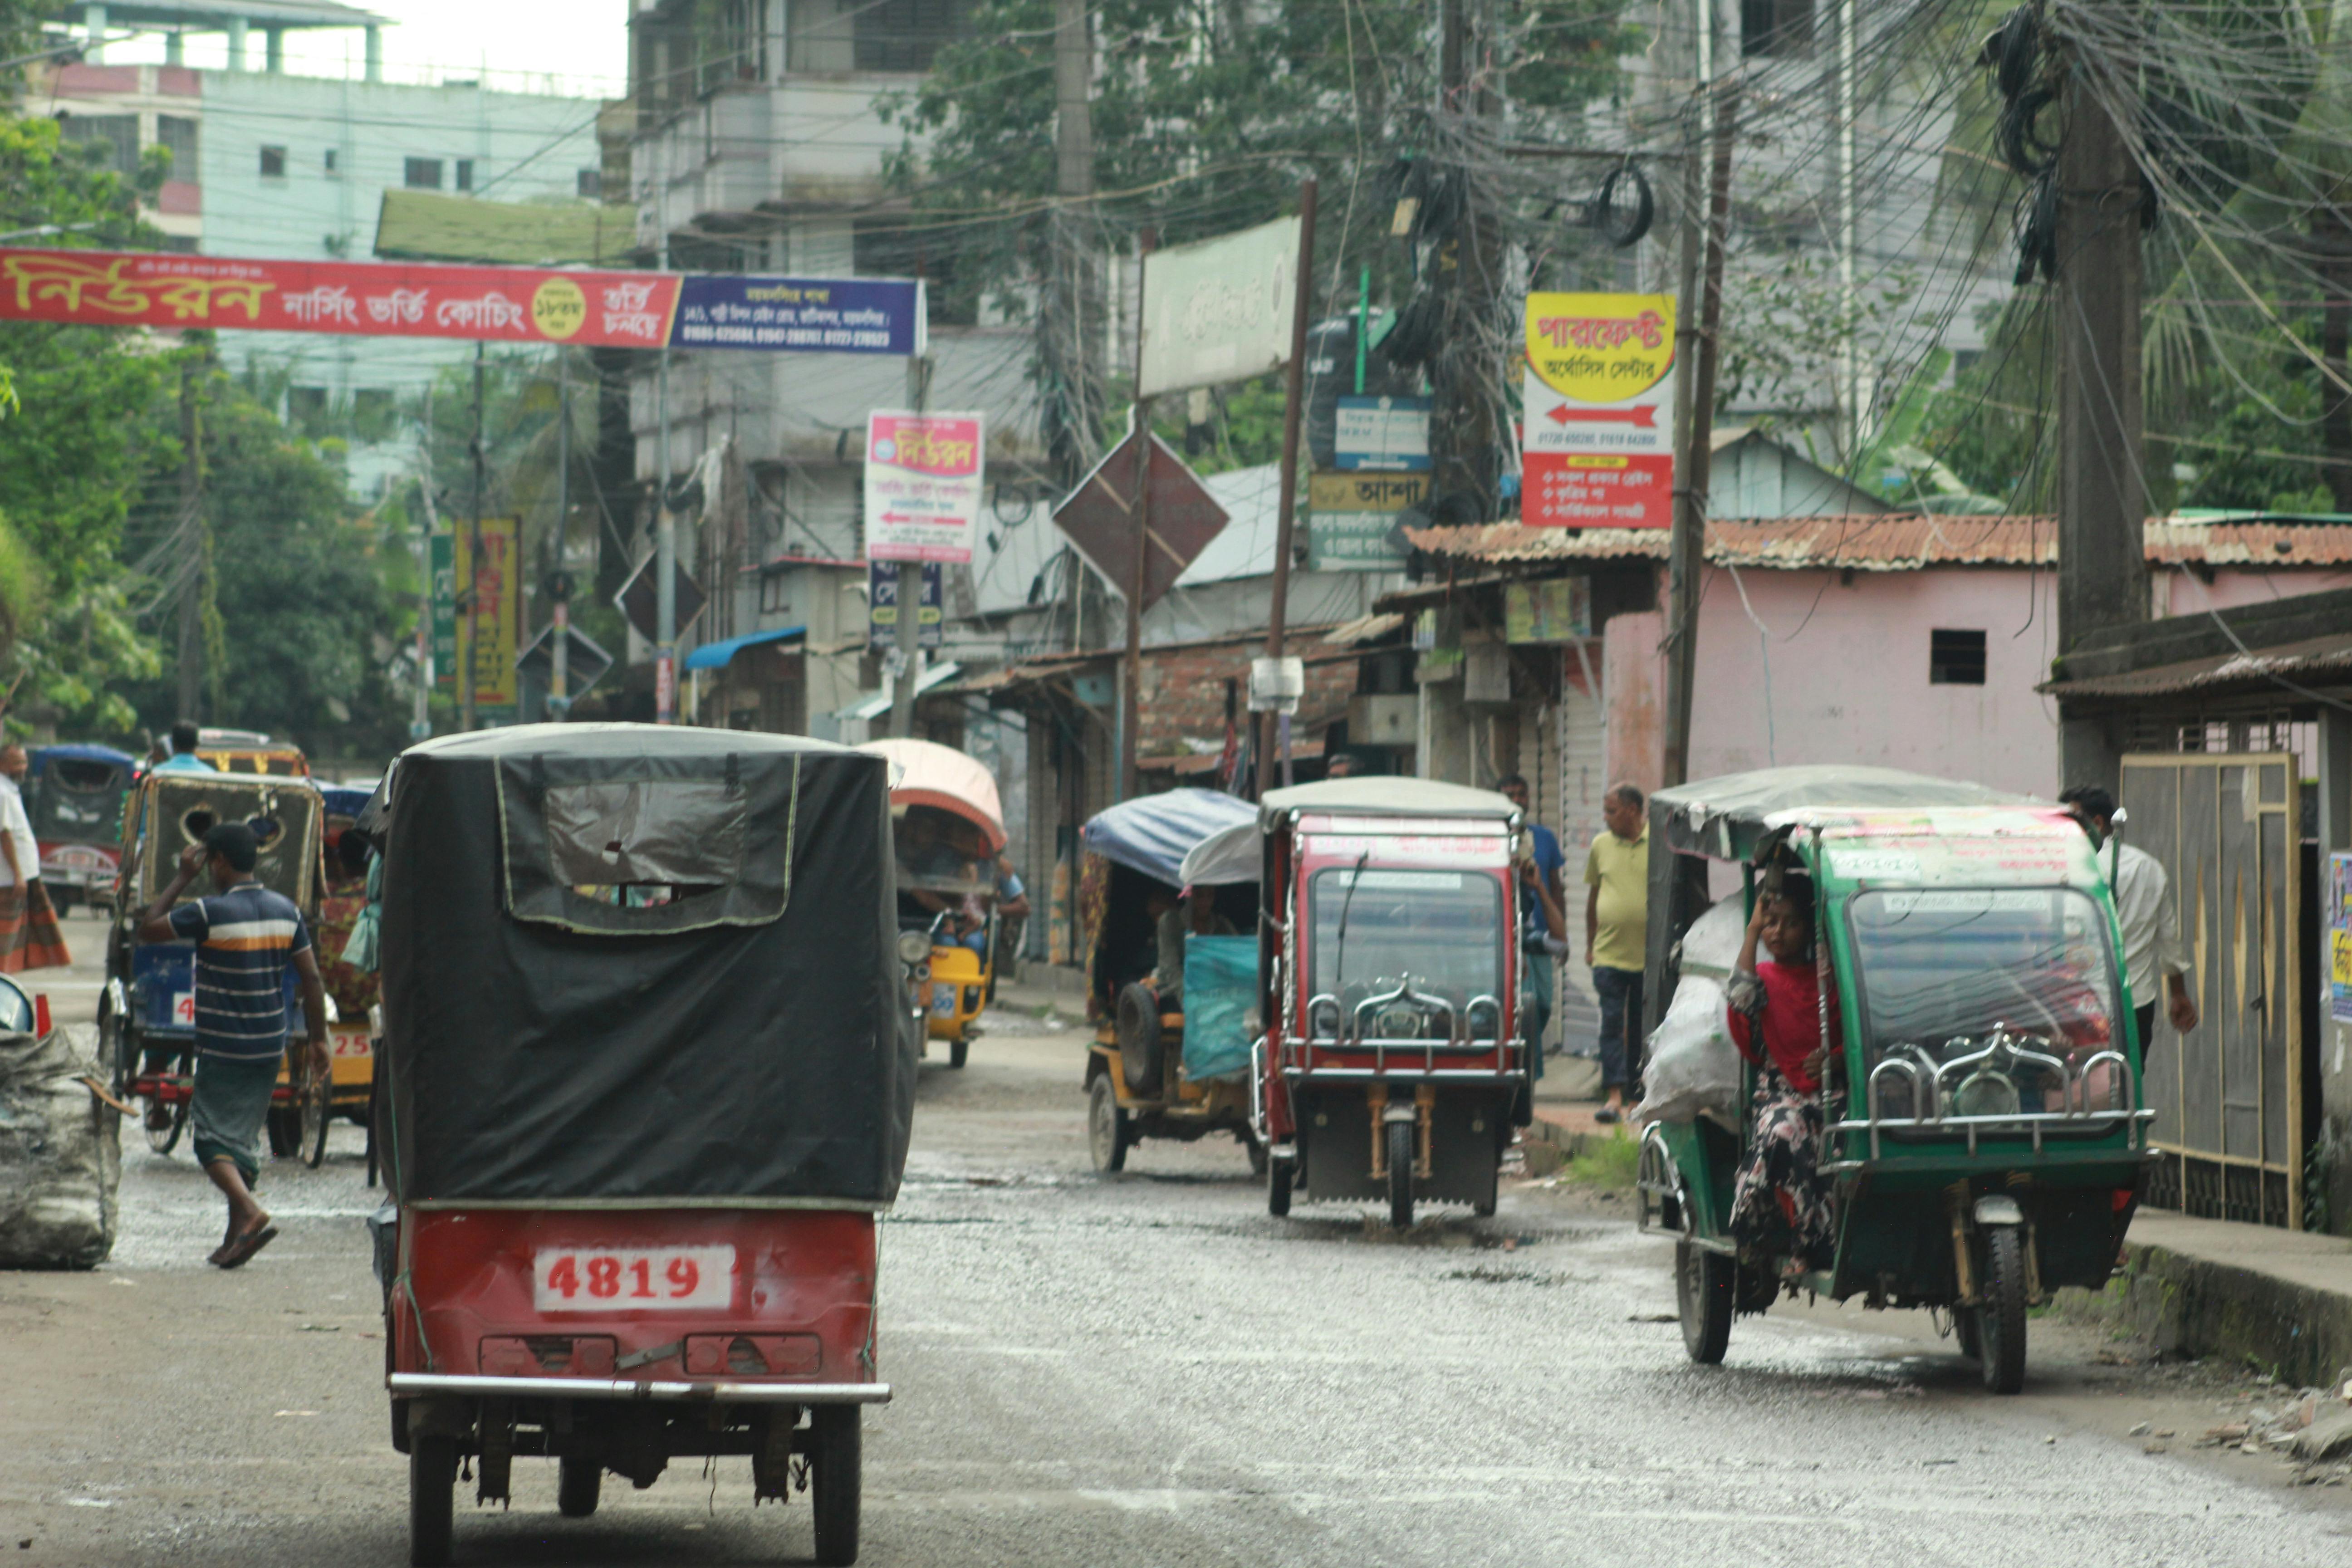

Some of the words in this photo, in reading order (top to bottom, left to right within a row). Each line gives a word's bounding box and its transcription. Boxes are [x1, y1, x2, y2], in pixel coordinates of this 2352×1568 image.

[3, 255, 275, 319] নিউরন
[282, 285, 359, 326] নার্সিং
[366, 289, 429, 326] ভর্তি
[436, 291, 526, 333] কোচিং
[603, 280, 657, 310] ভর্তি
[602, 312, 662, 339] চলছে
[1538, 309, 1666, 349] পারফেক্ট
[1610, 356, 1656, 379] সেন্টার
[894, 429, 973, 468] নিউরন
[548, 1256, 699, 1298] 4819
